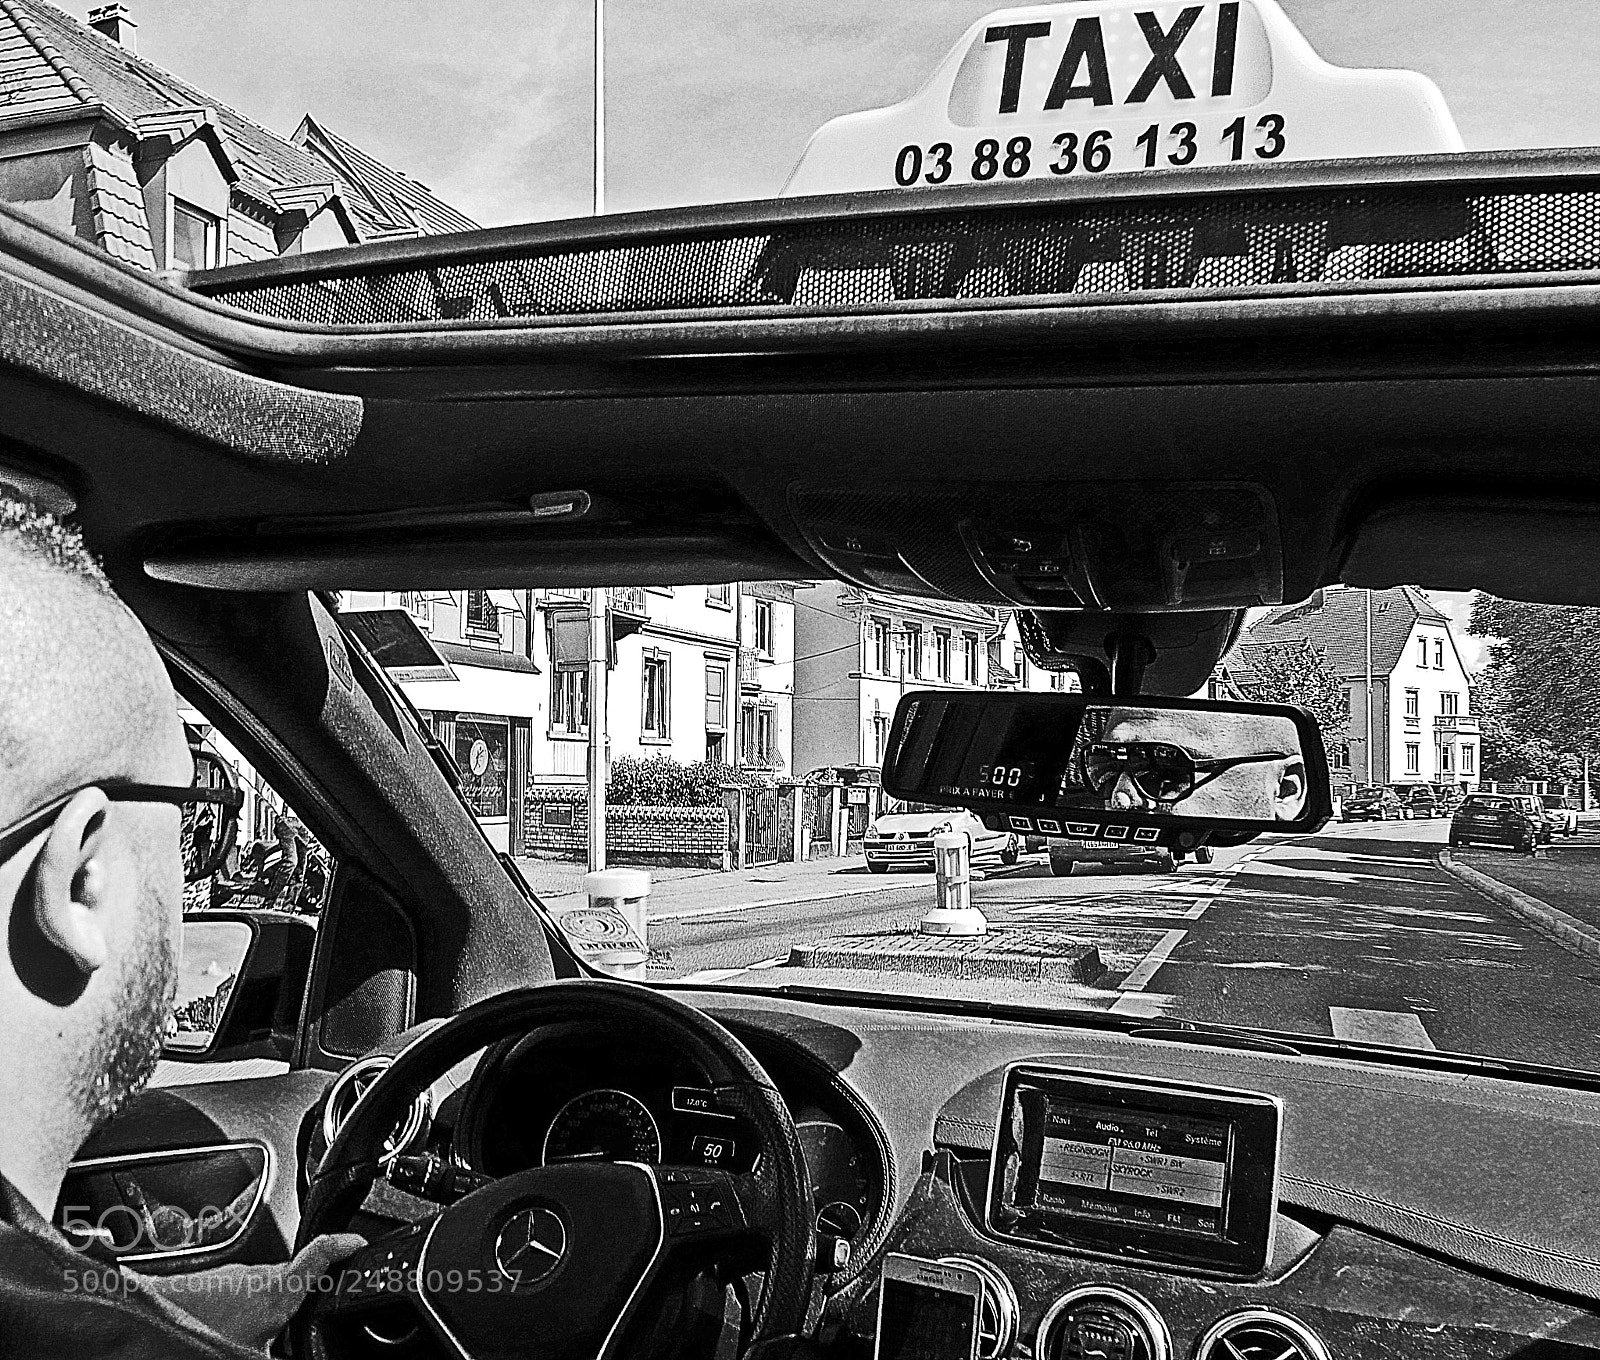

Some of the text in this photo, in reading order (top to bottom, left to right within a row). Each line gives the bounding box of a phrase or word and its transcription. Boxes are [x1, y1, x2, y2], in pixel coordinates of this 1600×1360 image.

[984, 2, 1240, 114] TAXI
[894, 114, 1286, 187] 03 88 36 13 13
[940, 785, 961, 795] PRIX
[972, 787, 1004, 799] PAYER
[1052, 1115, 1071, 1125] Navi
[1095, 1121, 1119, 1132] Audio
[1107, 1137, 1121, 1147] FM
[1141, 1141, 1161, 1152] MHz
[1184, 1133, 1222, 1147] Système
[703, 1143, 723, 1158] 50
[1111, 1163, 1153, 1178] SKYROCK
[1134, 1208, 1151, 1219] Info
[1197, 1218, 1215, 1229] Son
